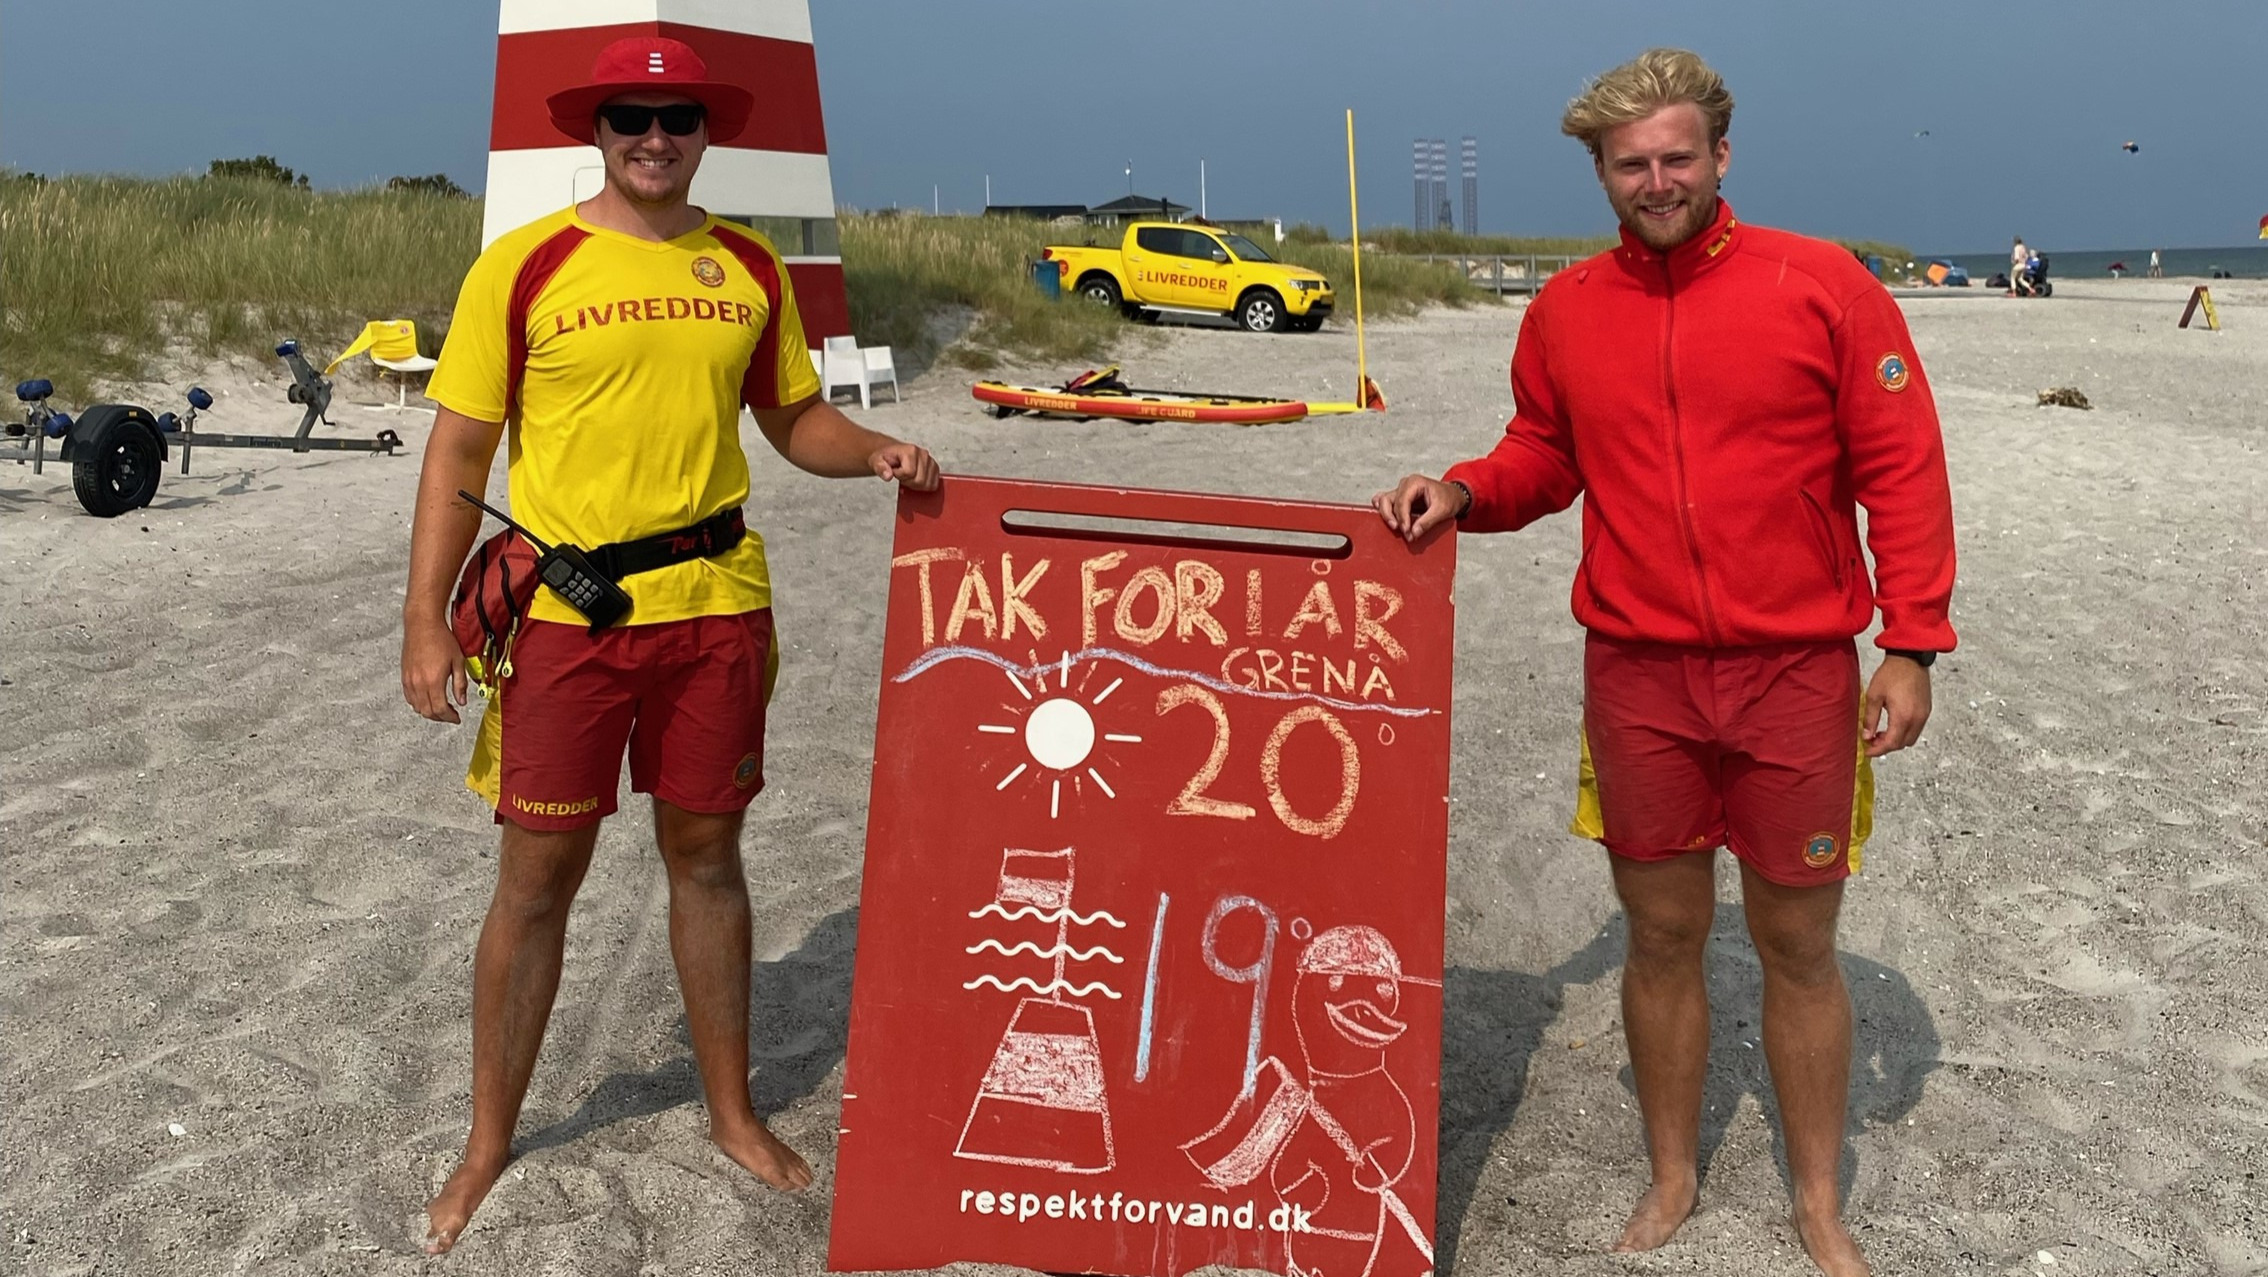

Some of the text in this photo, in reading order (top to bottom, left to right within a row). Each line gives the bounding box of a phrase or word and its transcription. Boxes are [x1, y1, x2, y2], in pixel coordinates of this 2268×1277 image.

[1147, 271, 1228, 292] LIVREDDER
[555, 297, 753, 335] LIVREDDER
[1024, 396, 1077, 410] LIVREDDER
[891, 546, 1409, 662] TAK FOR I ÅR
[1220, 646, 1396, 701] GRENÅ
[512, 793, 598, 816] LIVREDDER
[959, 1187, 1311, 1234] respektforvand.dk
